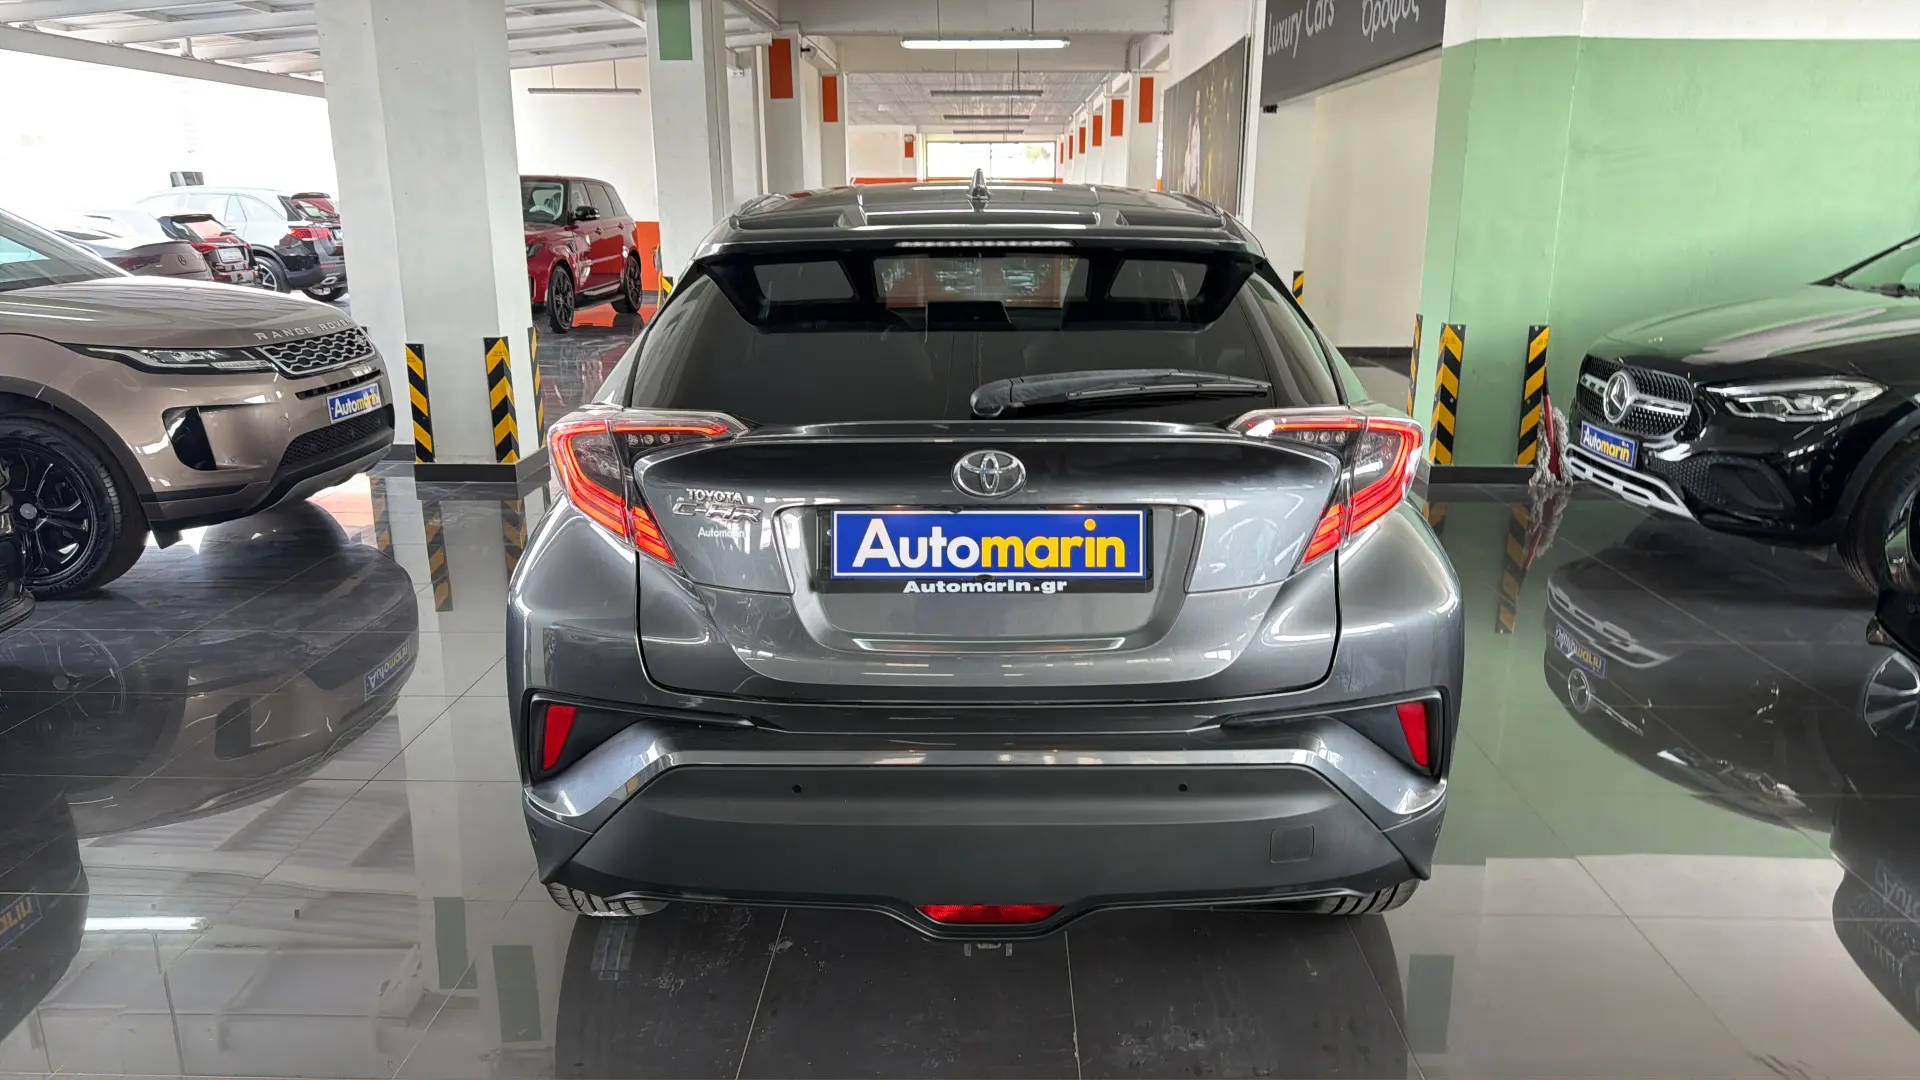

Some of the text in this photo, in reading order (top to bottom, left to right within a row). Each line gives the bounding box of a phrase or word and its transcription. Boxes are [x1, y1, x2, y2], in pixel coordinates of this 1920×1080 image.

[1267, 0, 1335, 59] Luxury Cars
[254, 317, 351, 341] RANGE ROVER
[1582, 426, 1630, 463] Automarin
[686, 488, 744, 504] TOYOTA
[852, 518, 1125, 568] Automarin
[903, 579, 1068, 594] Automarin.gr
